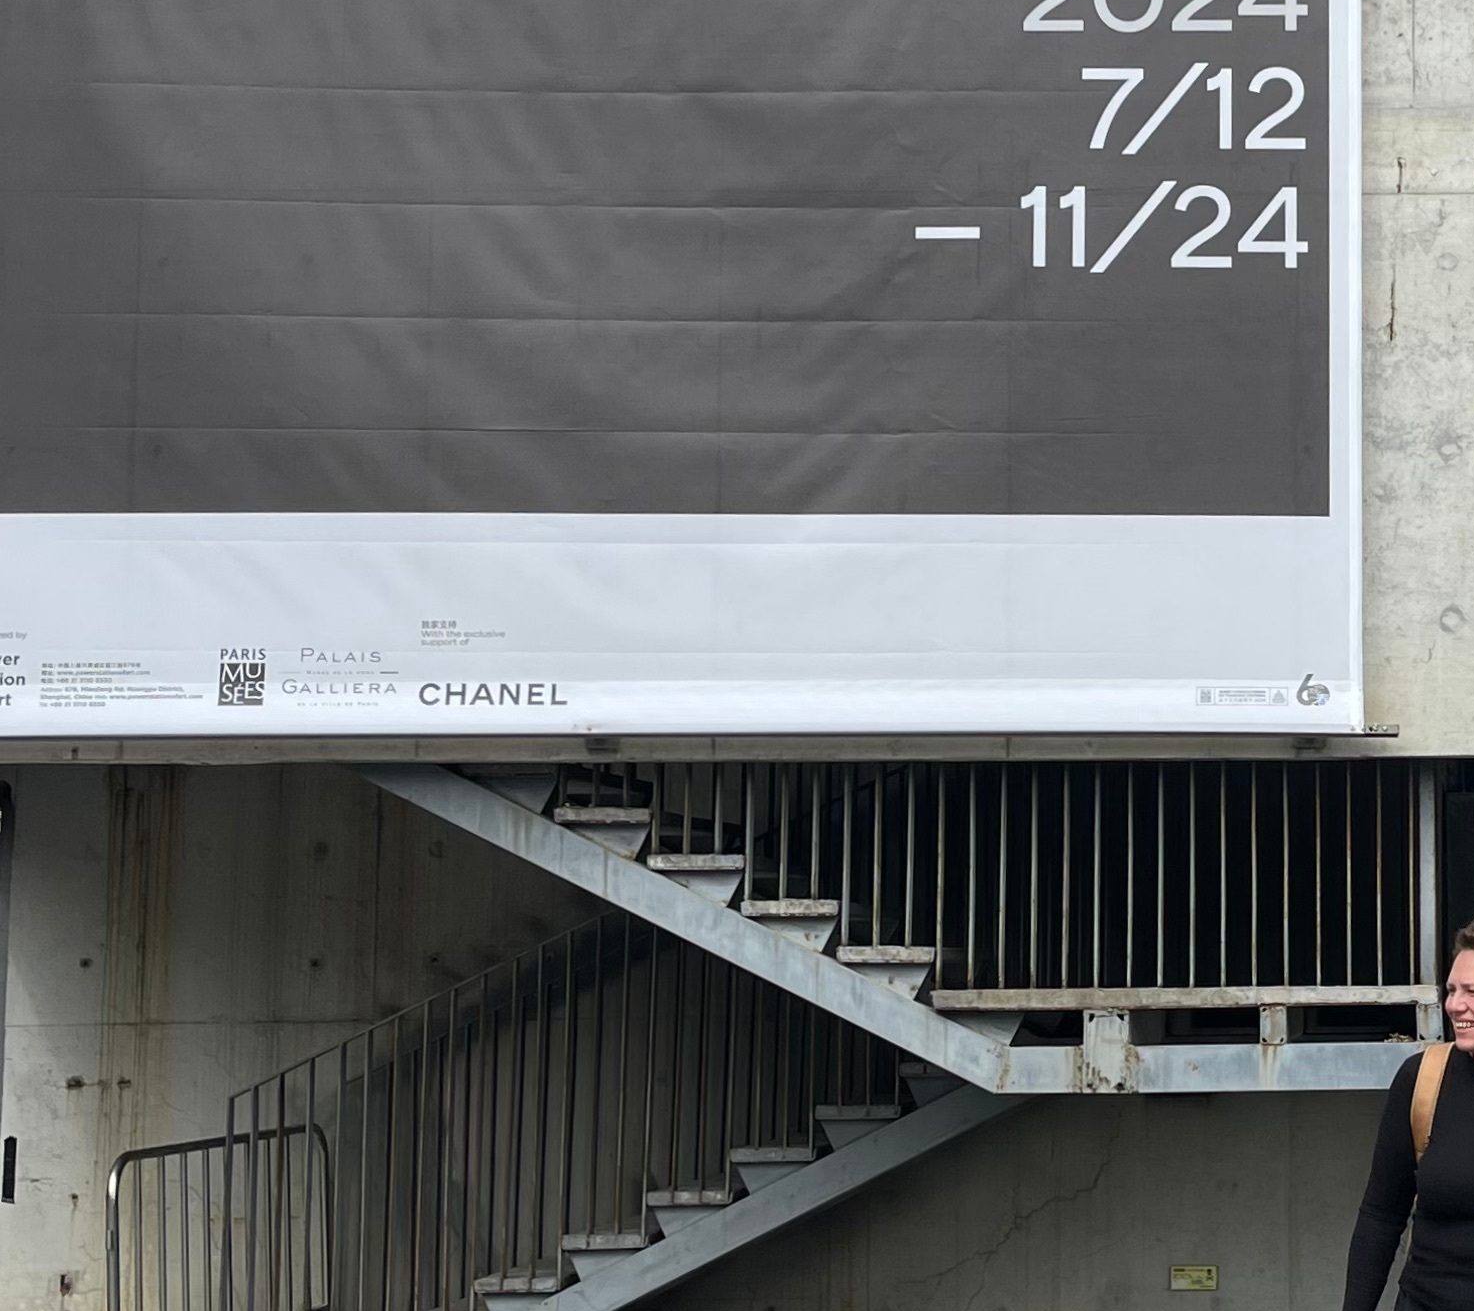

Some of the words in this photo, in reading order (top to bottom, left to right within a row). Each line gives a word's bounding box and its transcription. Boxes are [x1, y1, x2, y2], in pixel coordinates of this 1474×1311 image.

[1082, 62, 1306, 155] 7/12
[1020, 181, 1308, 273] 11/24
[0, 654, 20, 666] er
[220, 647, 267, 661] PARIS
[419, 682, 569, 706] CHANEL
